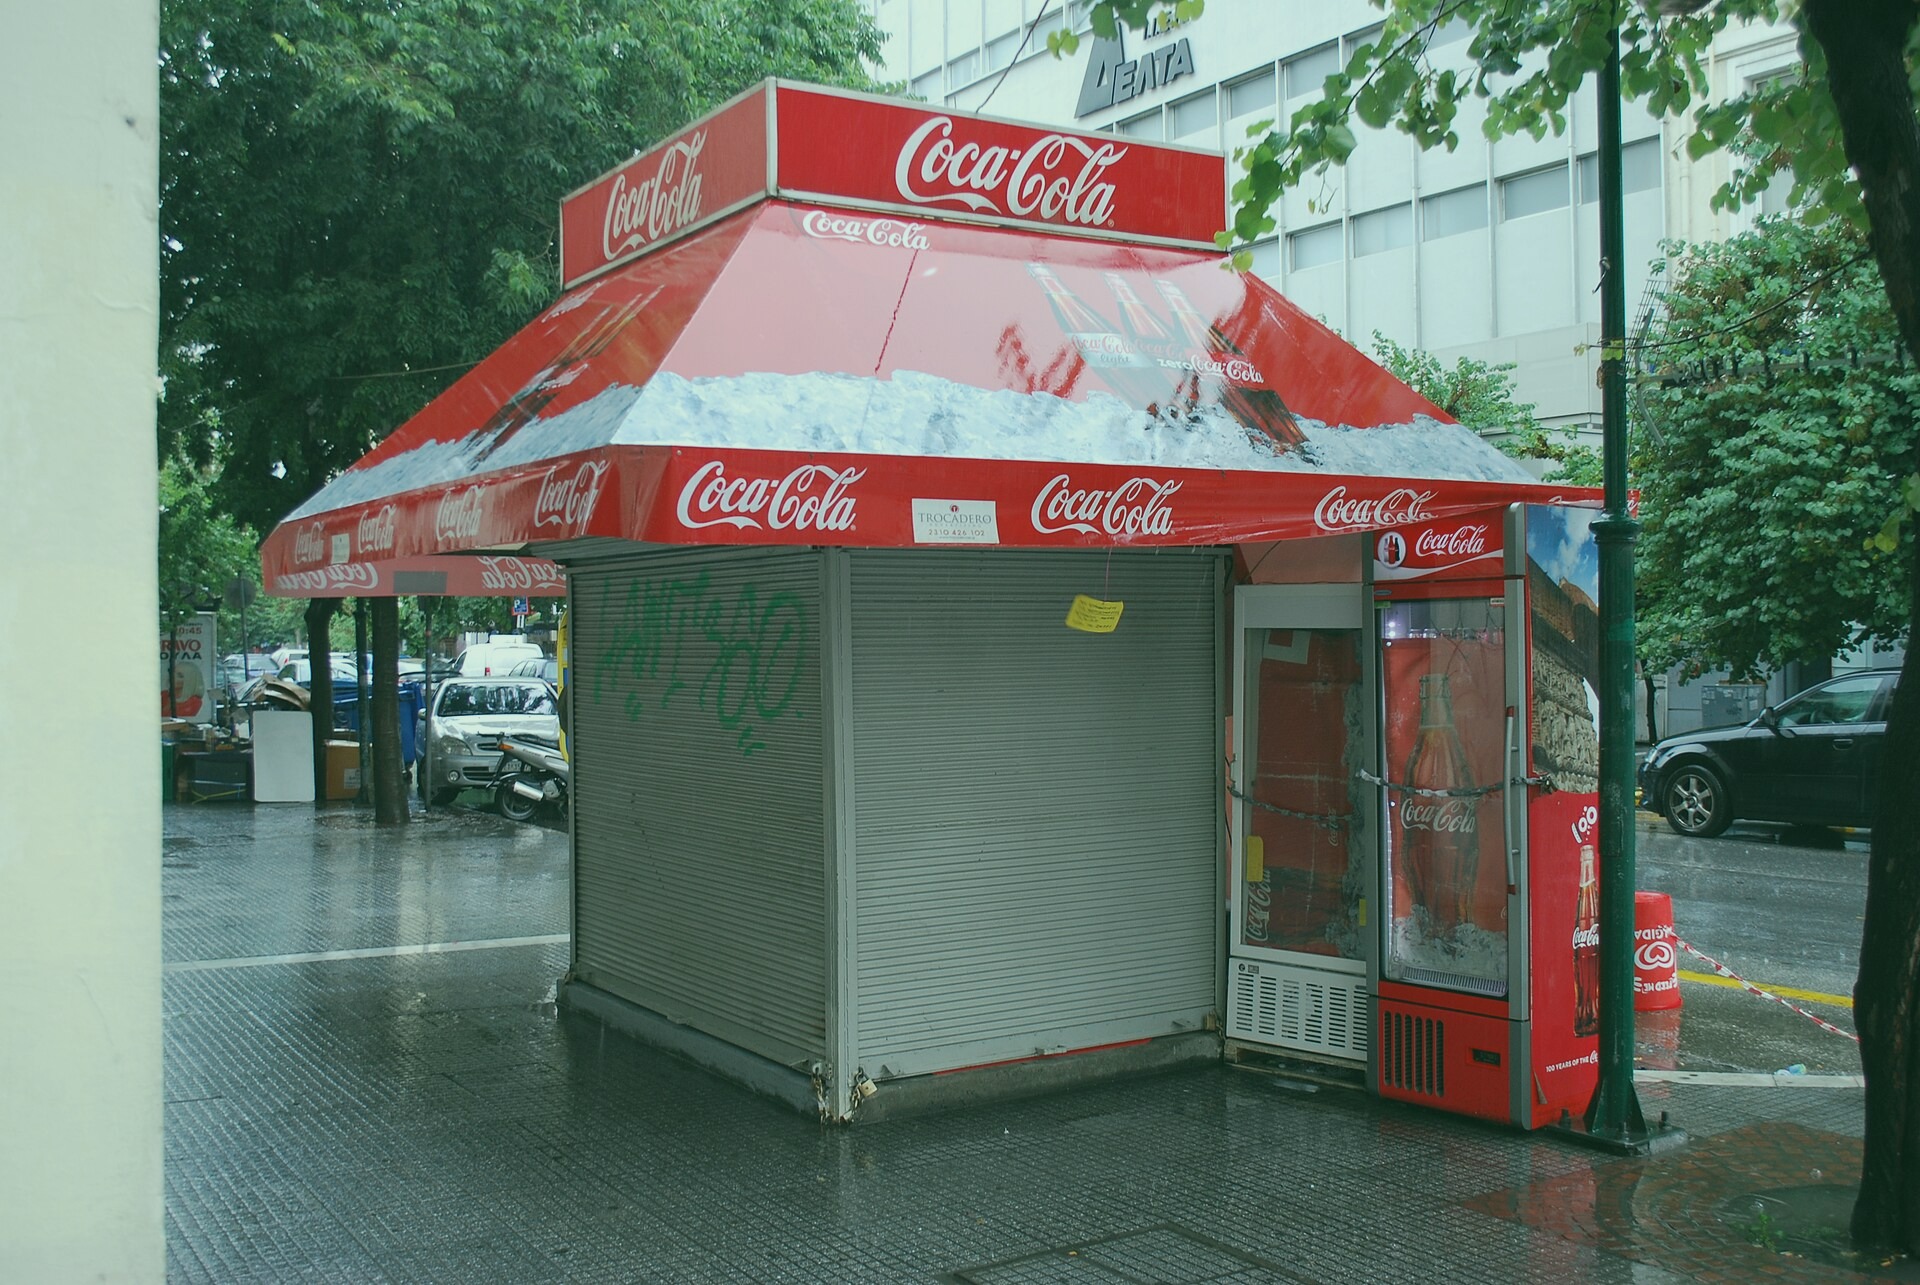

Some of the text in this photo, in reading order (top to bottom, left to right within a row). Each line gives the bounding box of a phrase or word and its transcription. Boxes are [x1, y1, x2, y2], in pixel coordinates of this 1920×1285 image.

[895, 116, 1128, 226] Coca-Cola
[603, 128, 708, 261] Coca-Cola
[802, 210, 929, 250] Coca-Cola
[1157, 358, 1192, 370] zero
[1190, 354, 1264, 384] Coca-Cola
[435, 484, 486, 541] Coca-Cola
[677, 461, 867, 531] Coca-Cola
[1031, 474, 1184, 535] Coca-Cola
[1314, 486, 1438, 530] Coca-Cola
[918, 512, 992, 524] TROCADERO
[971, 529, 985, 537] 102
[1415, 524, 1488, 556] Coca-Cola
[1400, 797, 1478, 834] Coca-Cola
[1556, 1061, 1571, 1070] YEARS
